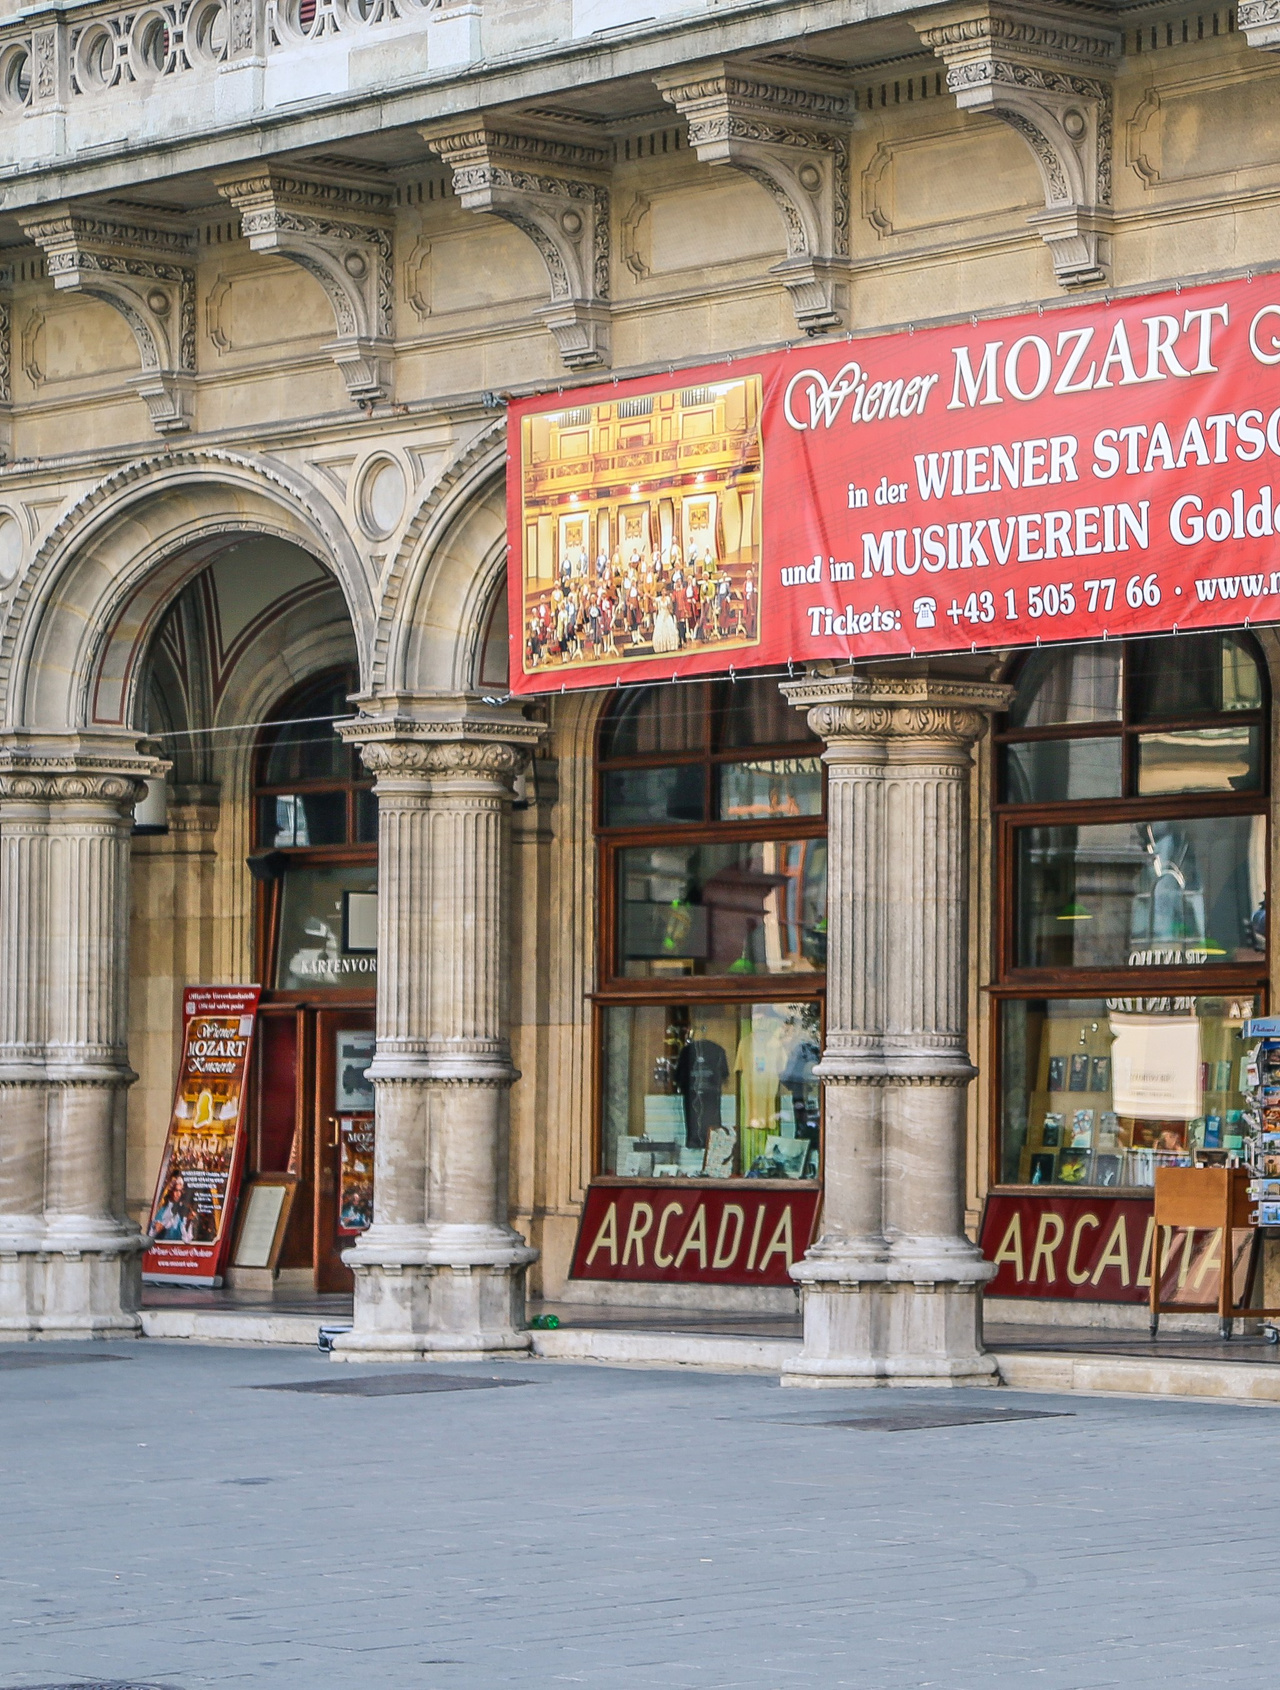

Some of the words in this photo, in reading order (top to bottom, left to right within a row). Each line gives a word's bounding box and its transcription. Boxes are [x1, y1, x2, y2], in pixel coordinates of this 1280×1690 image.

[784, 362, 939, 430] Wiener
[947, 303, 1229, 409] MOZART
[848, 484, 868, 509] in
[875, 477, 908, 505] der
[914, 435, 1078, 500] WIENER
[780, 556, 822, 587] und
[829, 557, 855, 582] im
[861, 500, 1150, 579] MUSIKVEREIN
[807, 605, 902, 637] Tickets:
[946, 590, 995, 625] +43
[1004, 589, 1019, 620] 1
[1028, 582, 1076, 618] 505
[1083, 578, 1118, 613] 77
[1126, 574, 1161, 609] 66
[187, 1040, 246, 1057] MOZART
[196, 1022, 237, 1039] Wiener
[585, 1201, 793, 1272] ARCADIA
